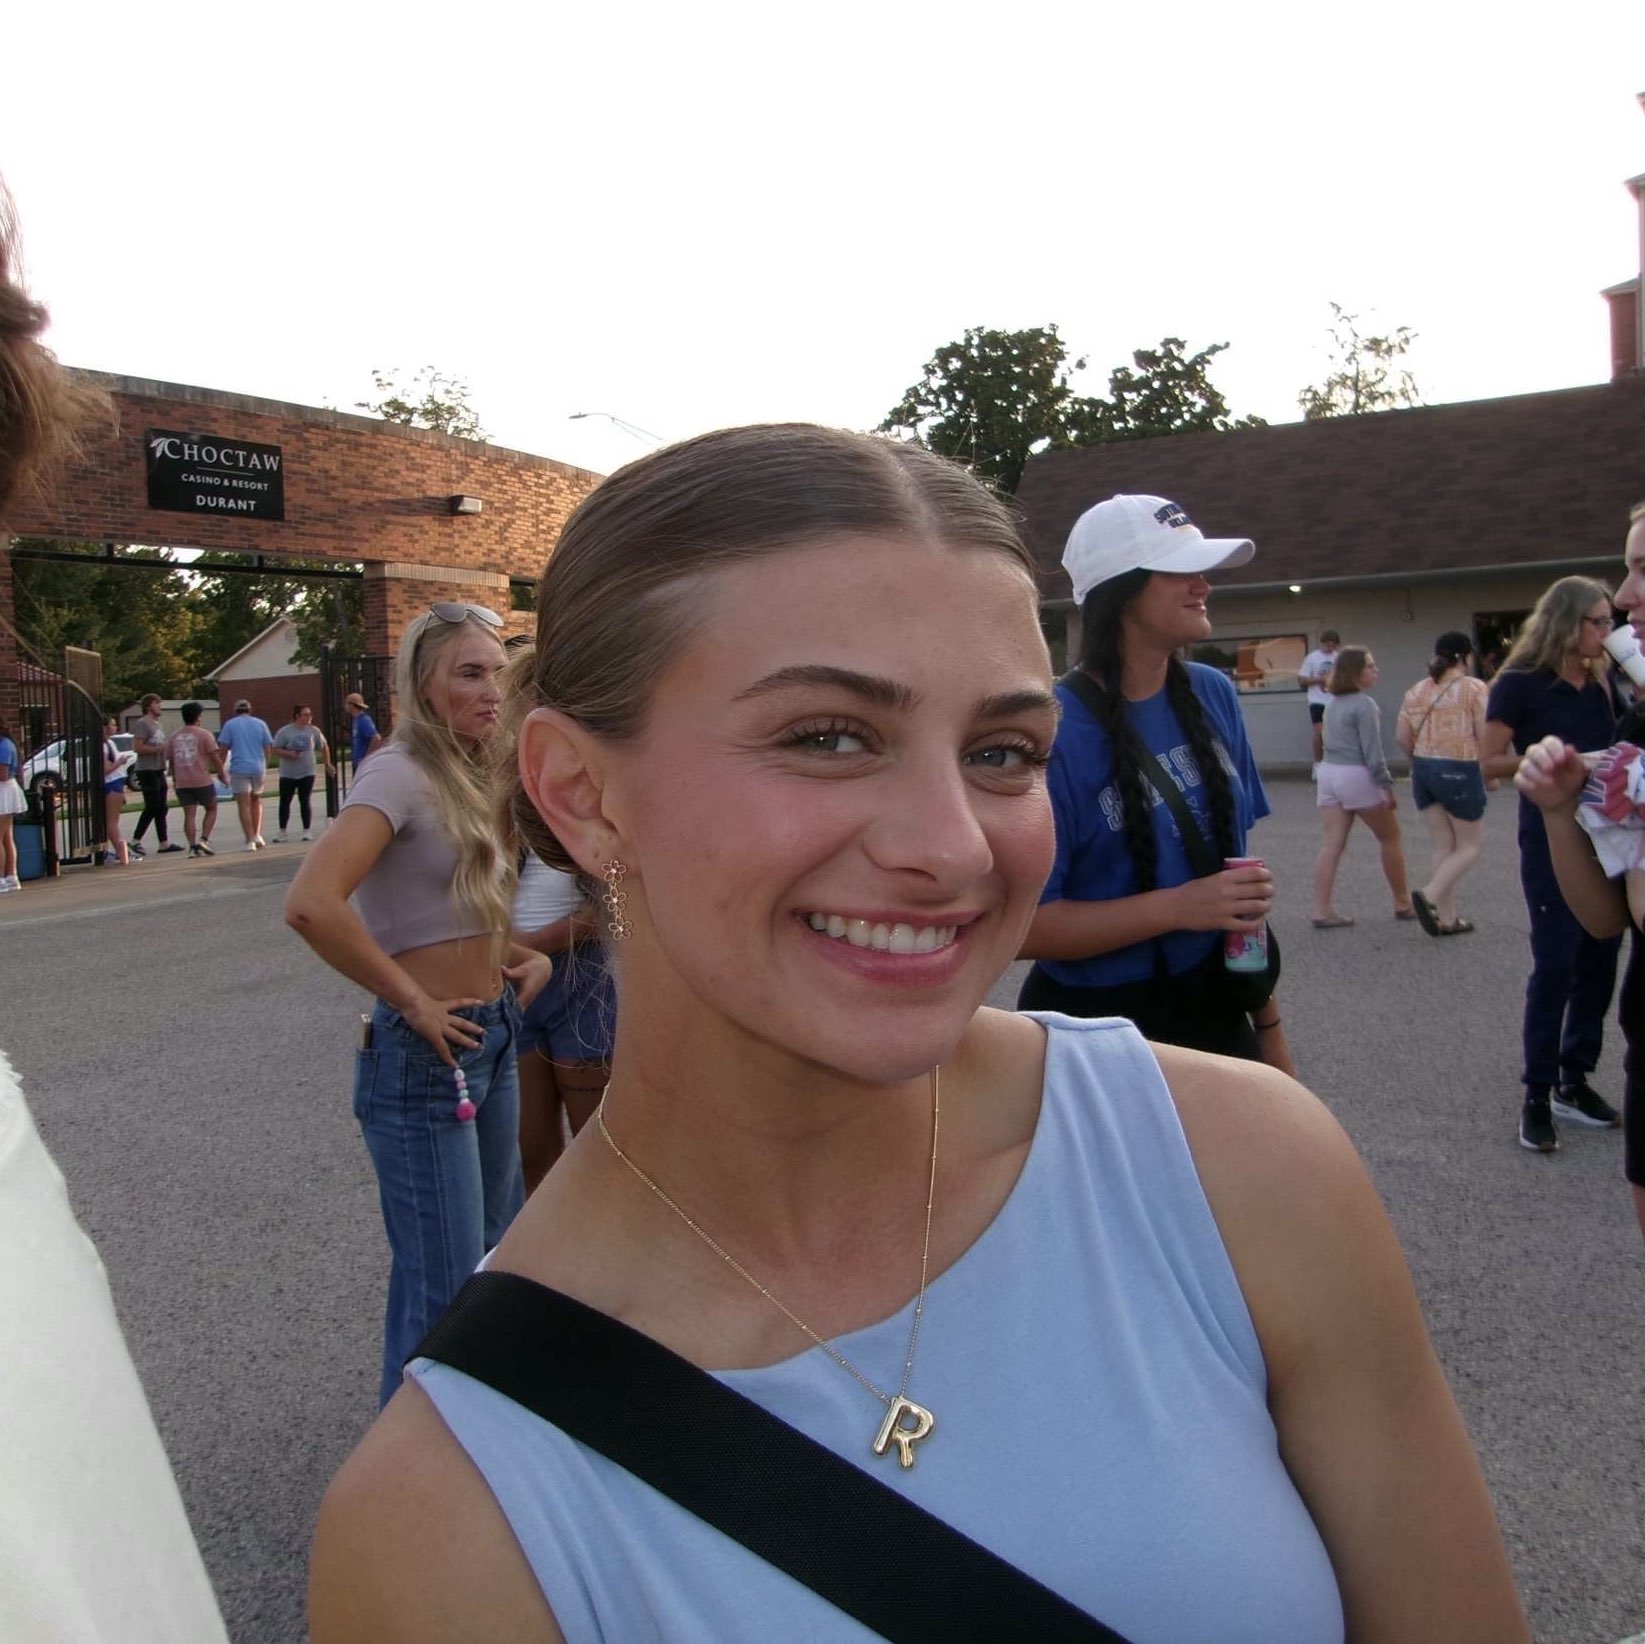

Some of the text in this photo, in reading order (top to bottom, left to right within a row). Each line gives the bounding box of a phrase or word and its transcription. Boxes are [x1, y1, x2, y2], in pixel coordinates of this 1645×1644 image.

[164, 438, 280, 471] CHOCTAW
[181, 473, 269, 491] CASINO & RESORT
[196, 494, 256, 511] DURANT
[872, 1395, 935, 1469] R
